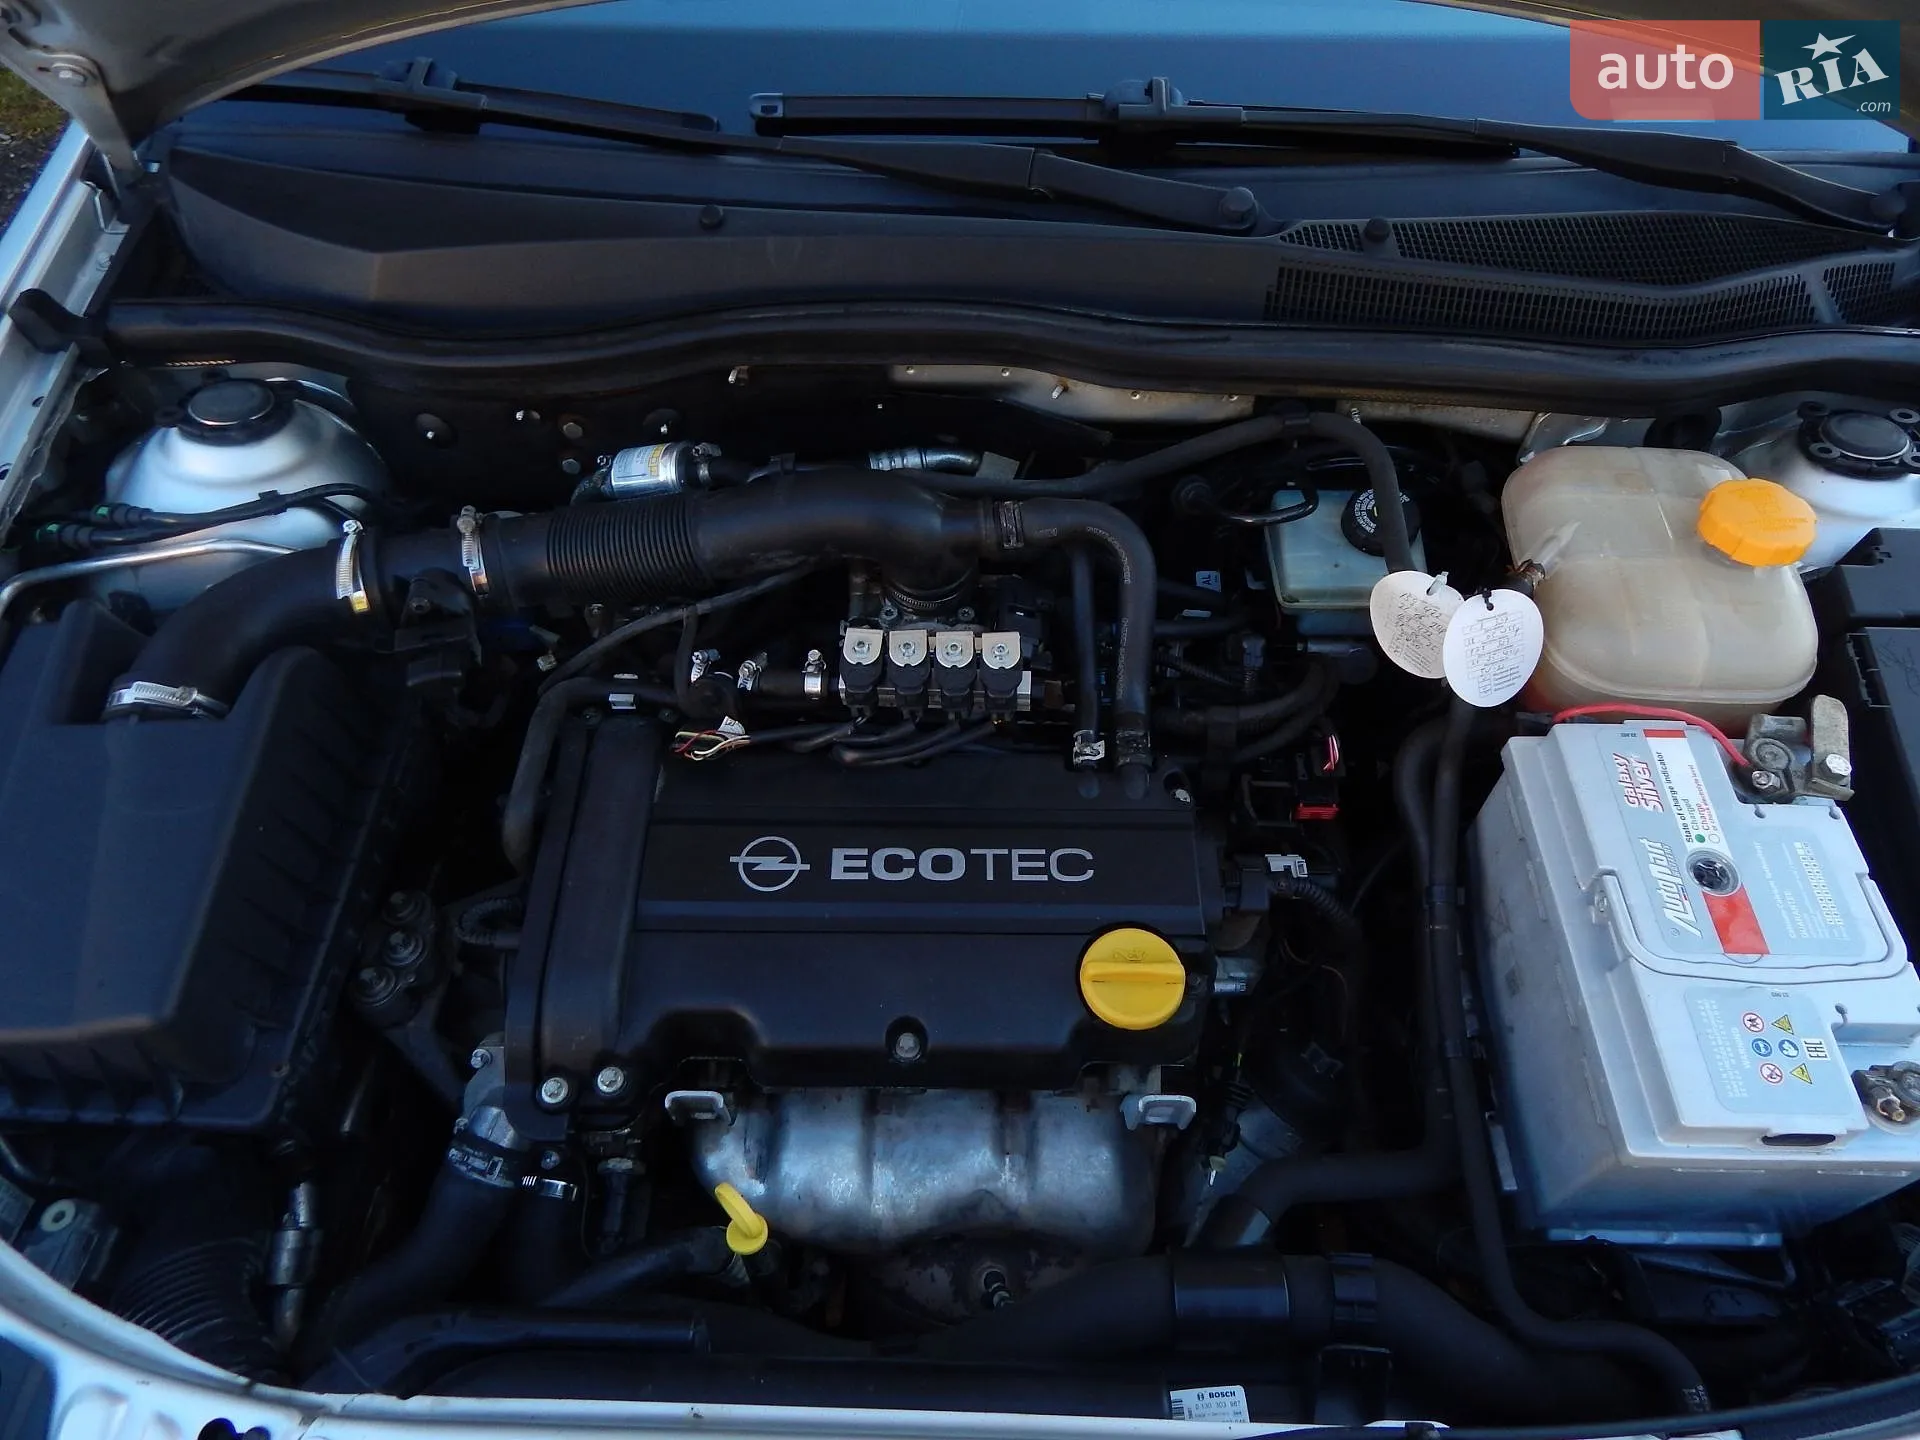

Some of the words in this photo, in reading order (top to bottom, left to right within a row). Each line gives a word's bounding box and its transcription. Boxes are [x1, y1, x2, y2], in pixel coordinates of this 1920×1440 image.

[1613, 752, 1641, 808] Galaxy
[1630, 756, 1665, 813] Silver
[1655, 751, 1673, 785] indicator
[1668, 786, 1684, 812] charge
[1682, 798, 1700, 831] Charged
[1677, 812, 1687, 821] of
[1680, 823, 1694, 843] State
[831, 848, 1095, 882] ECOTEC
[1208, 1390, 1236, 1399] BOSCH
